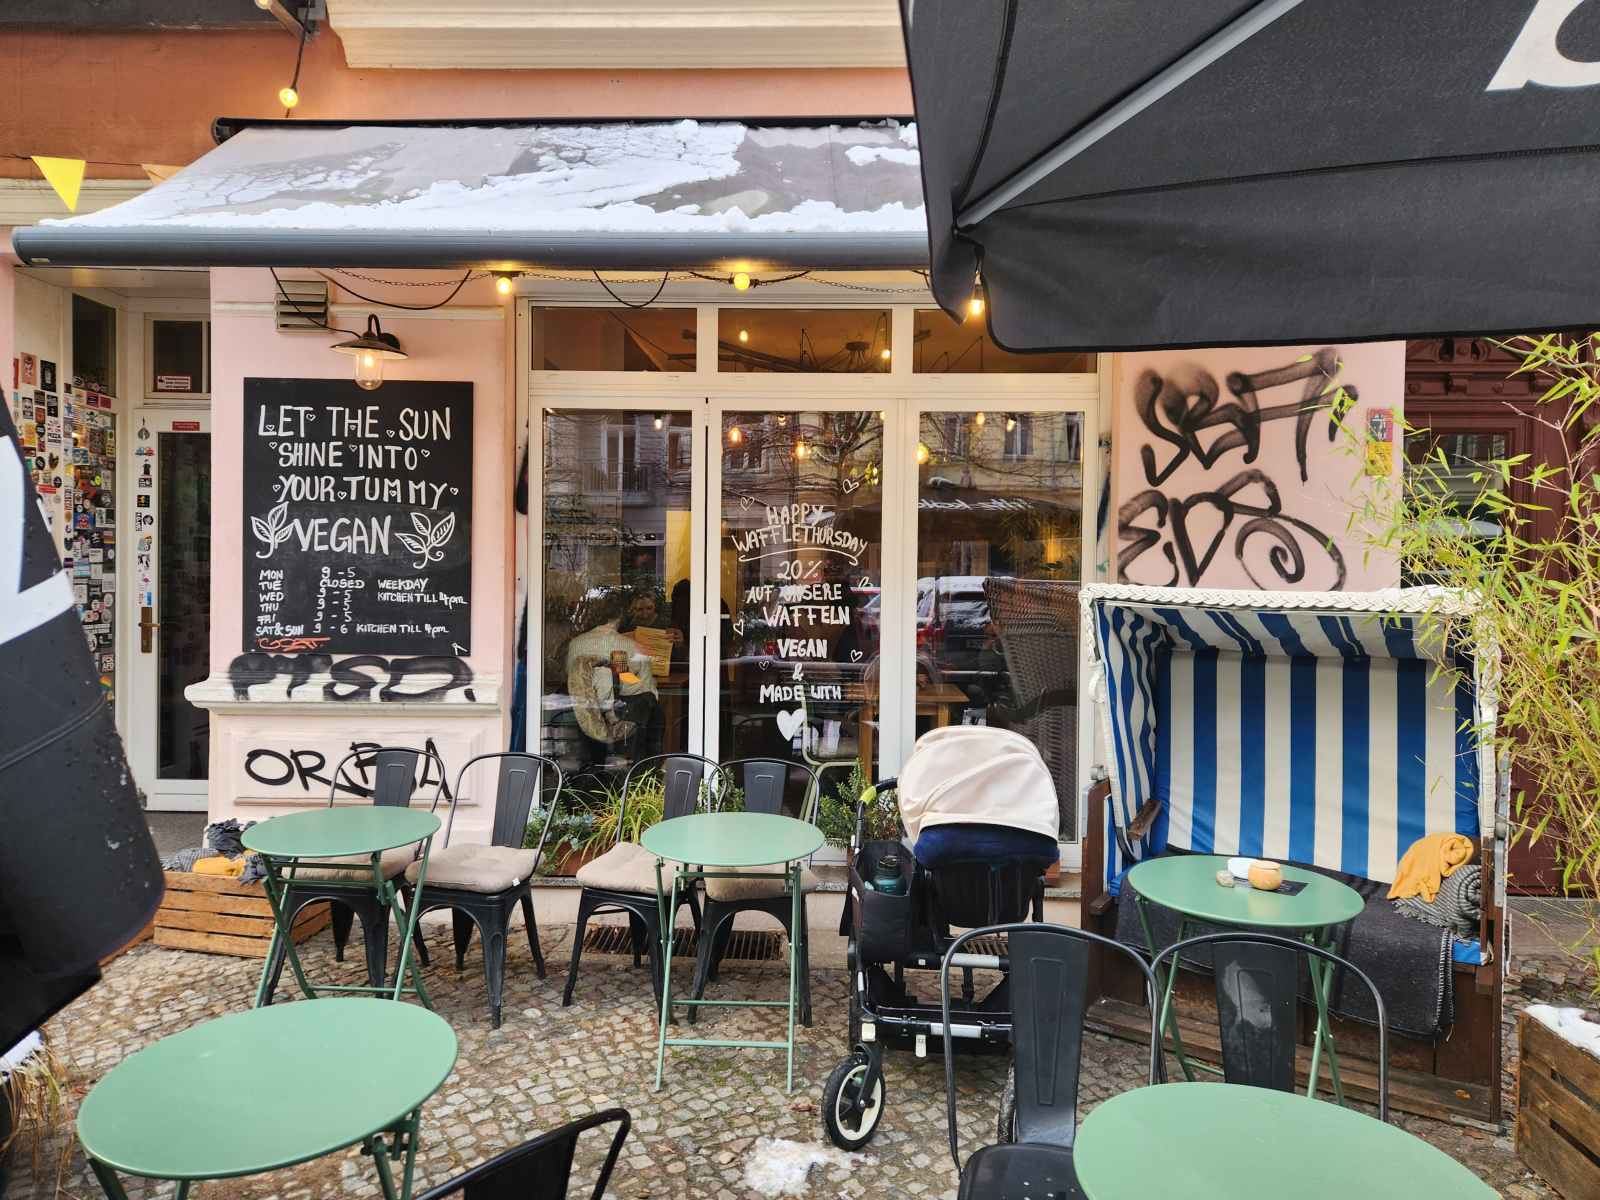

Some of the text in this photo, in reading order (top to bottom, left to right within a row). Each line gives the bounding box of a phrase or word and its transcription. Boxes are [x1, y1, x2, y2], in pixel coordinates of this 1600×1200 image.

[258, 405, 451, 441] LET THE SUN
[279, 441, 418, 471] SHINE INTO
[276, 474, 448, 510] YOUR TUMMY
[766, 503, 824, 526] HAPPY
[292, 515, 392, 555] VEGAN
[259, 569, 284, 580] MON
[777, 560, 822, 580] 20%
[259, 578, 365, 591] TUE CLOSED
[377, 577, 429, 592] WEEKDAY
[745, 583, 842, 603] AUF UNSERE
[259, 591, 284, 603] WED
[377, 591, 414, 603] KITCHEN
[414, 593, 438, 603] TILL
[260, 602, 279, 613] THU
[763, 605, 850, 627] WAFFELN
[257, 613, 276, 626] FRI
[356, 623, 397, 633] KITCHEN
[399, 624, 422, 633] TILL
[777, 638, 827, 658] VEGAN
[792, 663, 804, 681] &
[759, 685, 841, 703] MADE WITH
